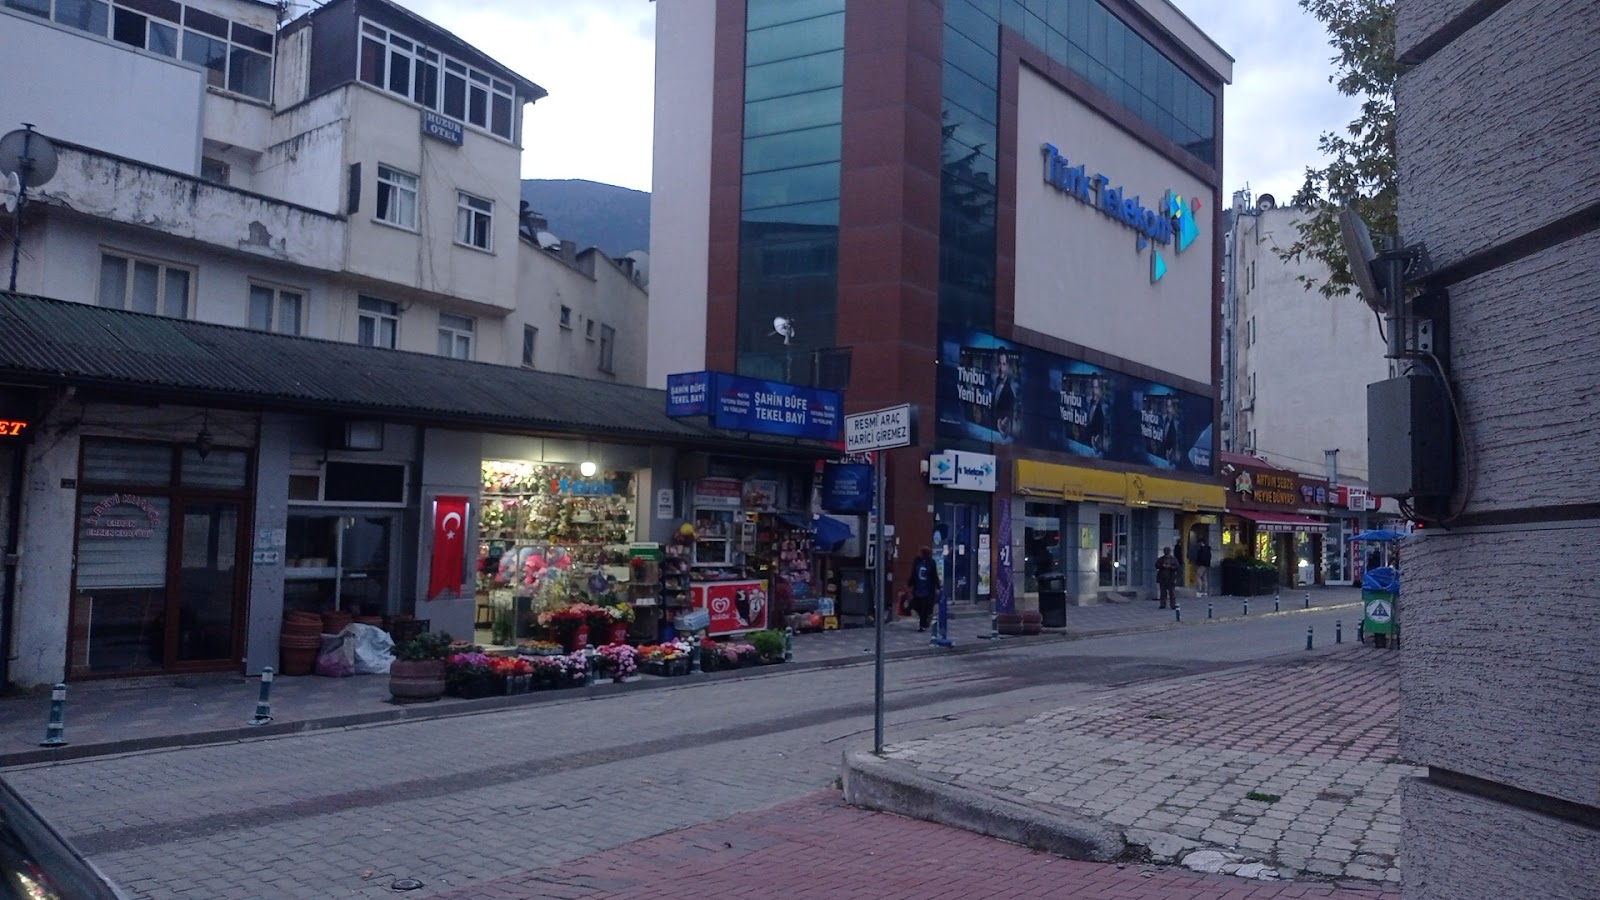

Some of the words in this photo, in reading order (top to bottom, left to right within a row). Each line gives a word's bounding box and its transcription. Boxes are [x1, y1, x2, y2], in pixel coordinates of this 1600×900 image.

[428, 113, 461, 133] HUZUR
[1041, 143, 1091, 206] Türk
[1092, 173, 1171, 246] Telekom
[957, 366, 986, 387] Tivibu
[754, 391, 783, 407] ŞAHİN
[784, 394, 808, 411] BÜFE
[956, 384, 975, 404] Yeni
[976, 388, 992, 409] bu!
[1060, 391, 1082, 408] Tivibu
[754, 407, 784, 422] TEKEL
[785, 410, 806, 425] BAYİ
[854, 413, 879, 431] RESMİ
[880, 412, 900, 427] ARAÇ
[1059, 406, 1074, 423] Yeni
[1074, 409, 1088, 428] bu!
[848, 429, 874, 446] HARİCİ
[875, 426, 906, 442] GİREMEZ
